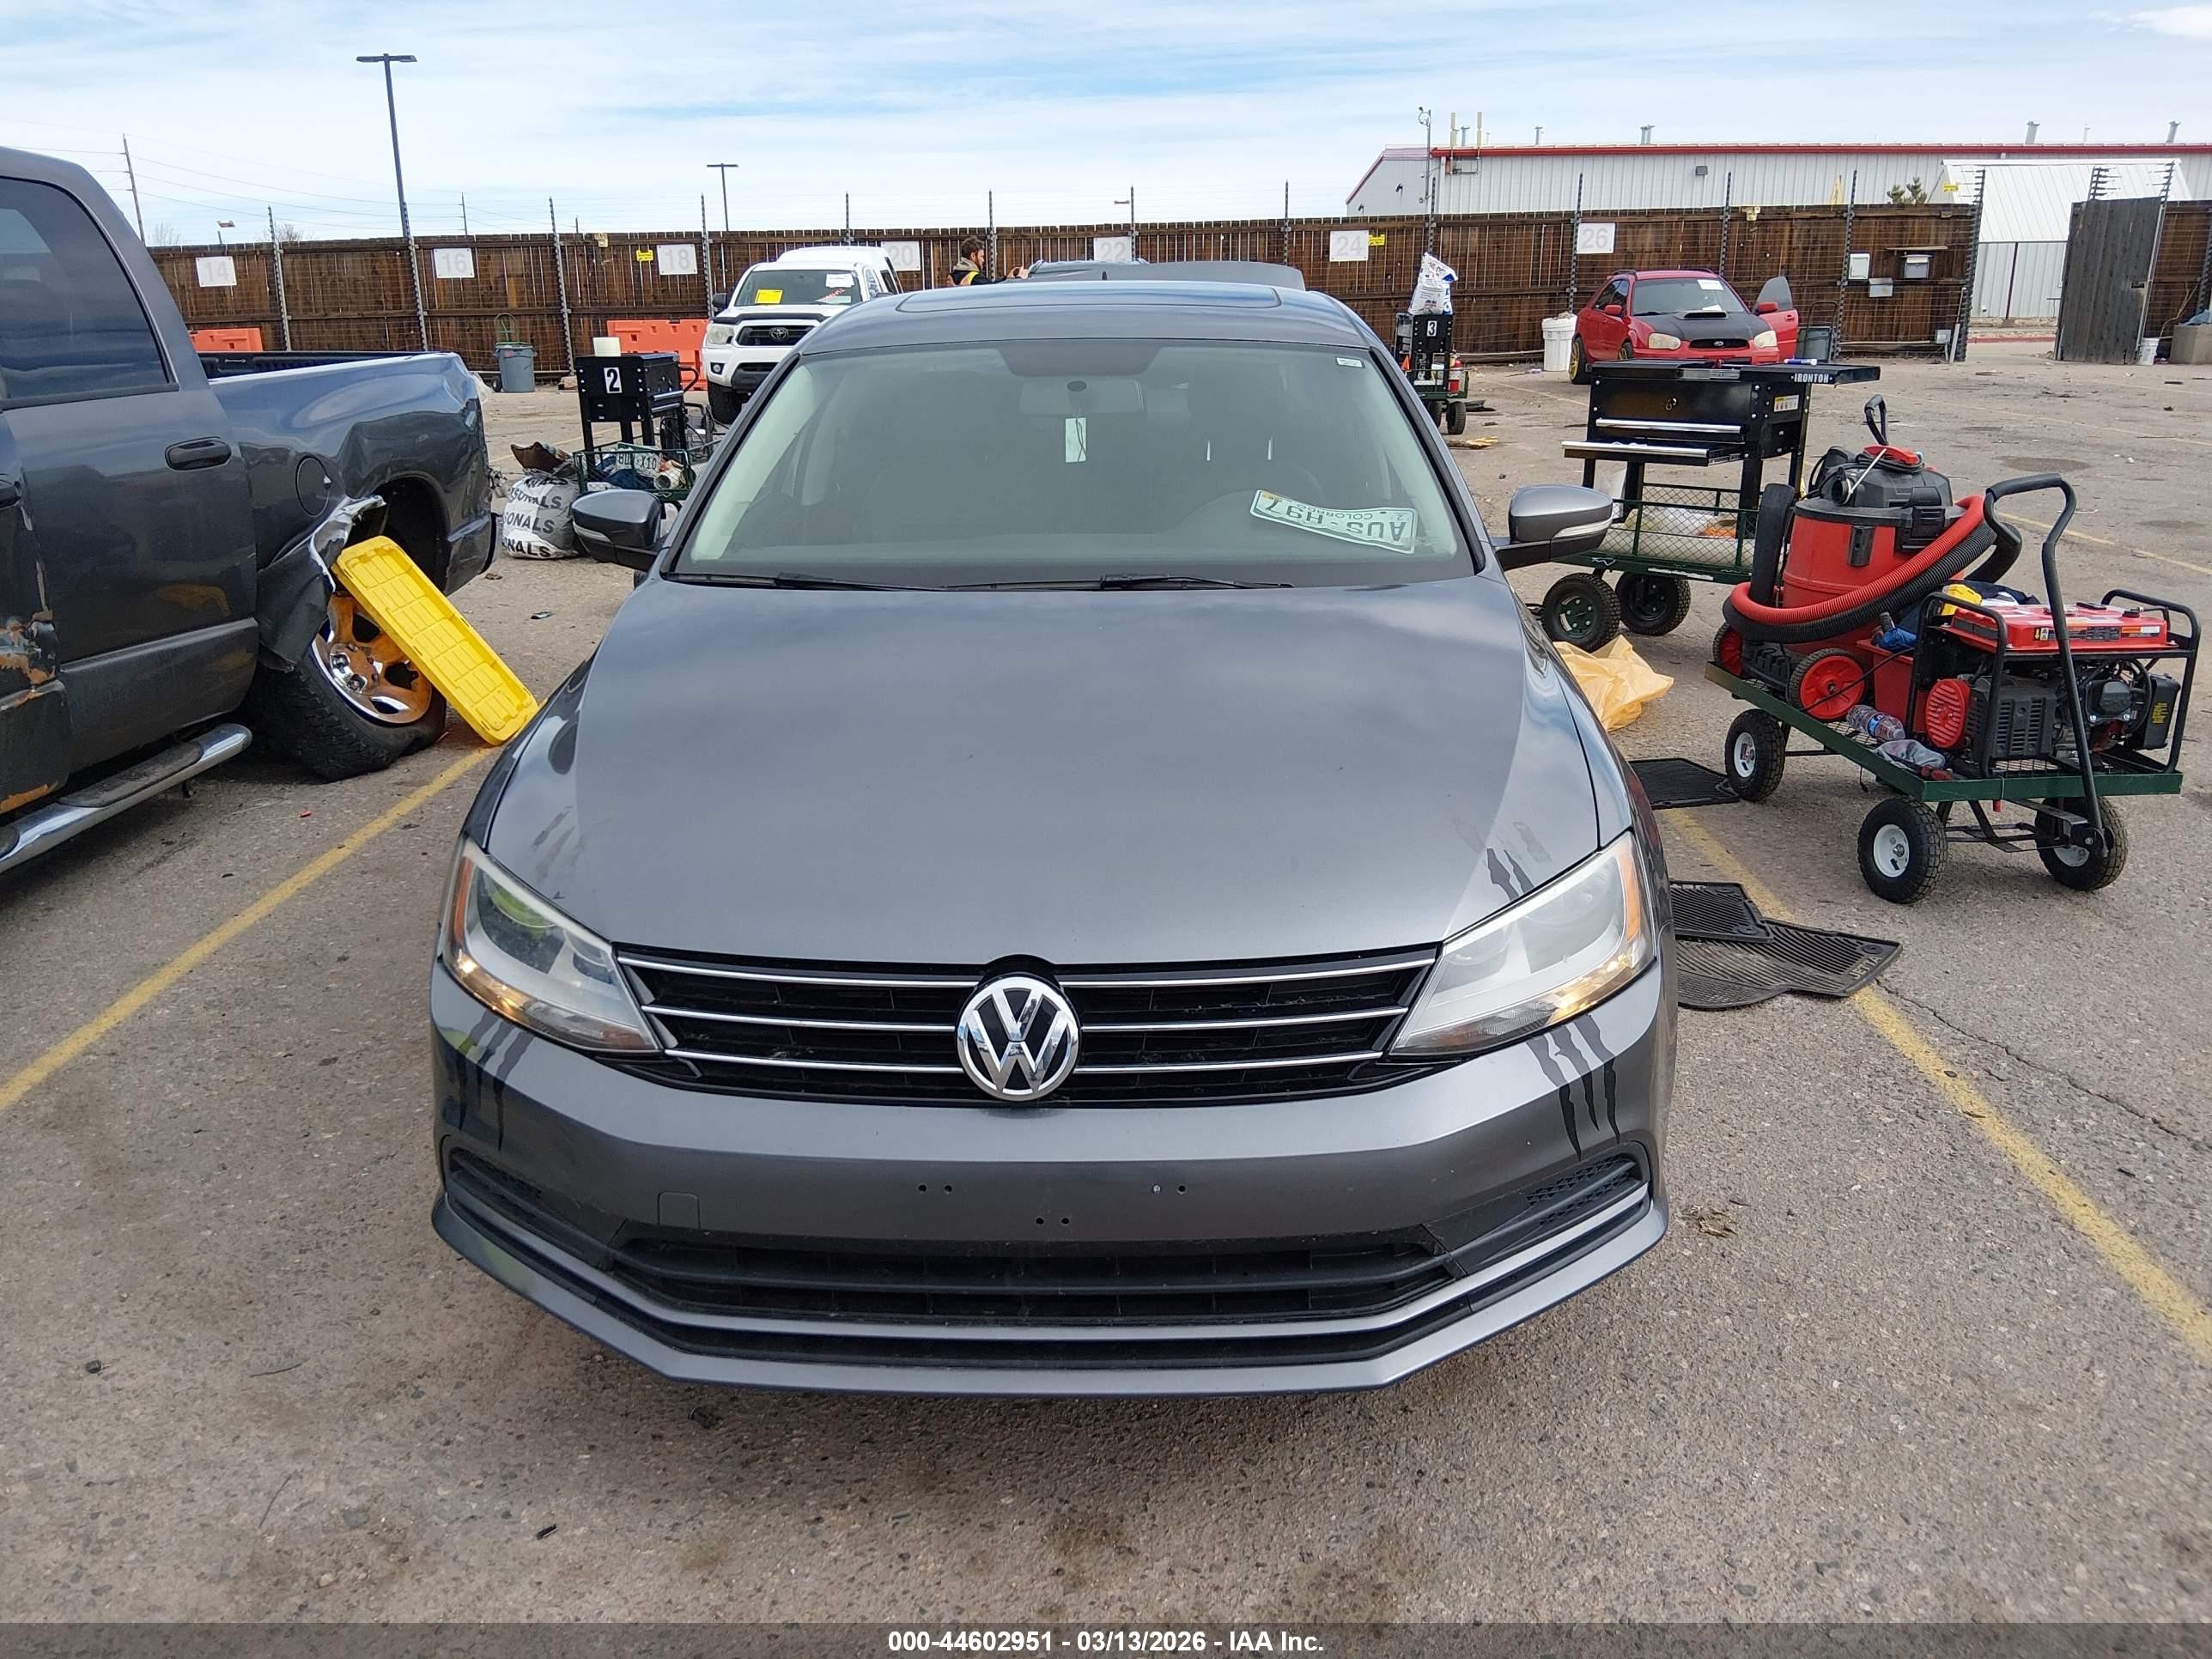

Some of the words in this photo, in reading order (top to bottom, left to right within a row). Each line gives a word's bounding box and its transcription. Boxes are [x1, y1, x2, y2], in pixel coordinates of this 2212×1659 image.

[1337, 235, 1361, 257] 24
[1582, 228, 1608, 249] 26
[665, 247, 690, 270] 18
[888, 245, 914, 266] 20
[1100, 241, 1127, 262] 22
[204, 260, 230, 283] 14
[441, 252, 468, 274] 16
[1428, 320, 1437, 336] 3
[606, 368, 621, 392] 2
[1793, 372, 1830, 384] IRONTON
[1297, 503, 1374, 521] COLORADO
[957, 976, 1079, 1102] VW
